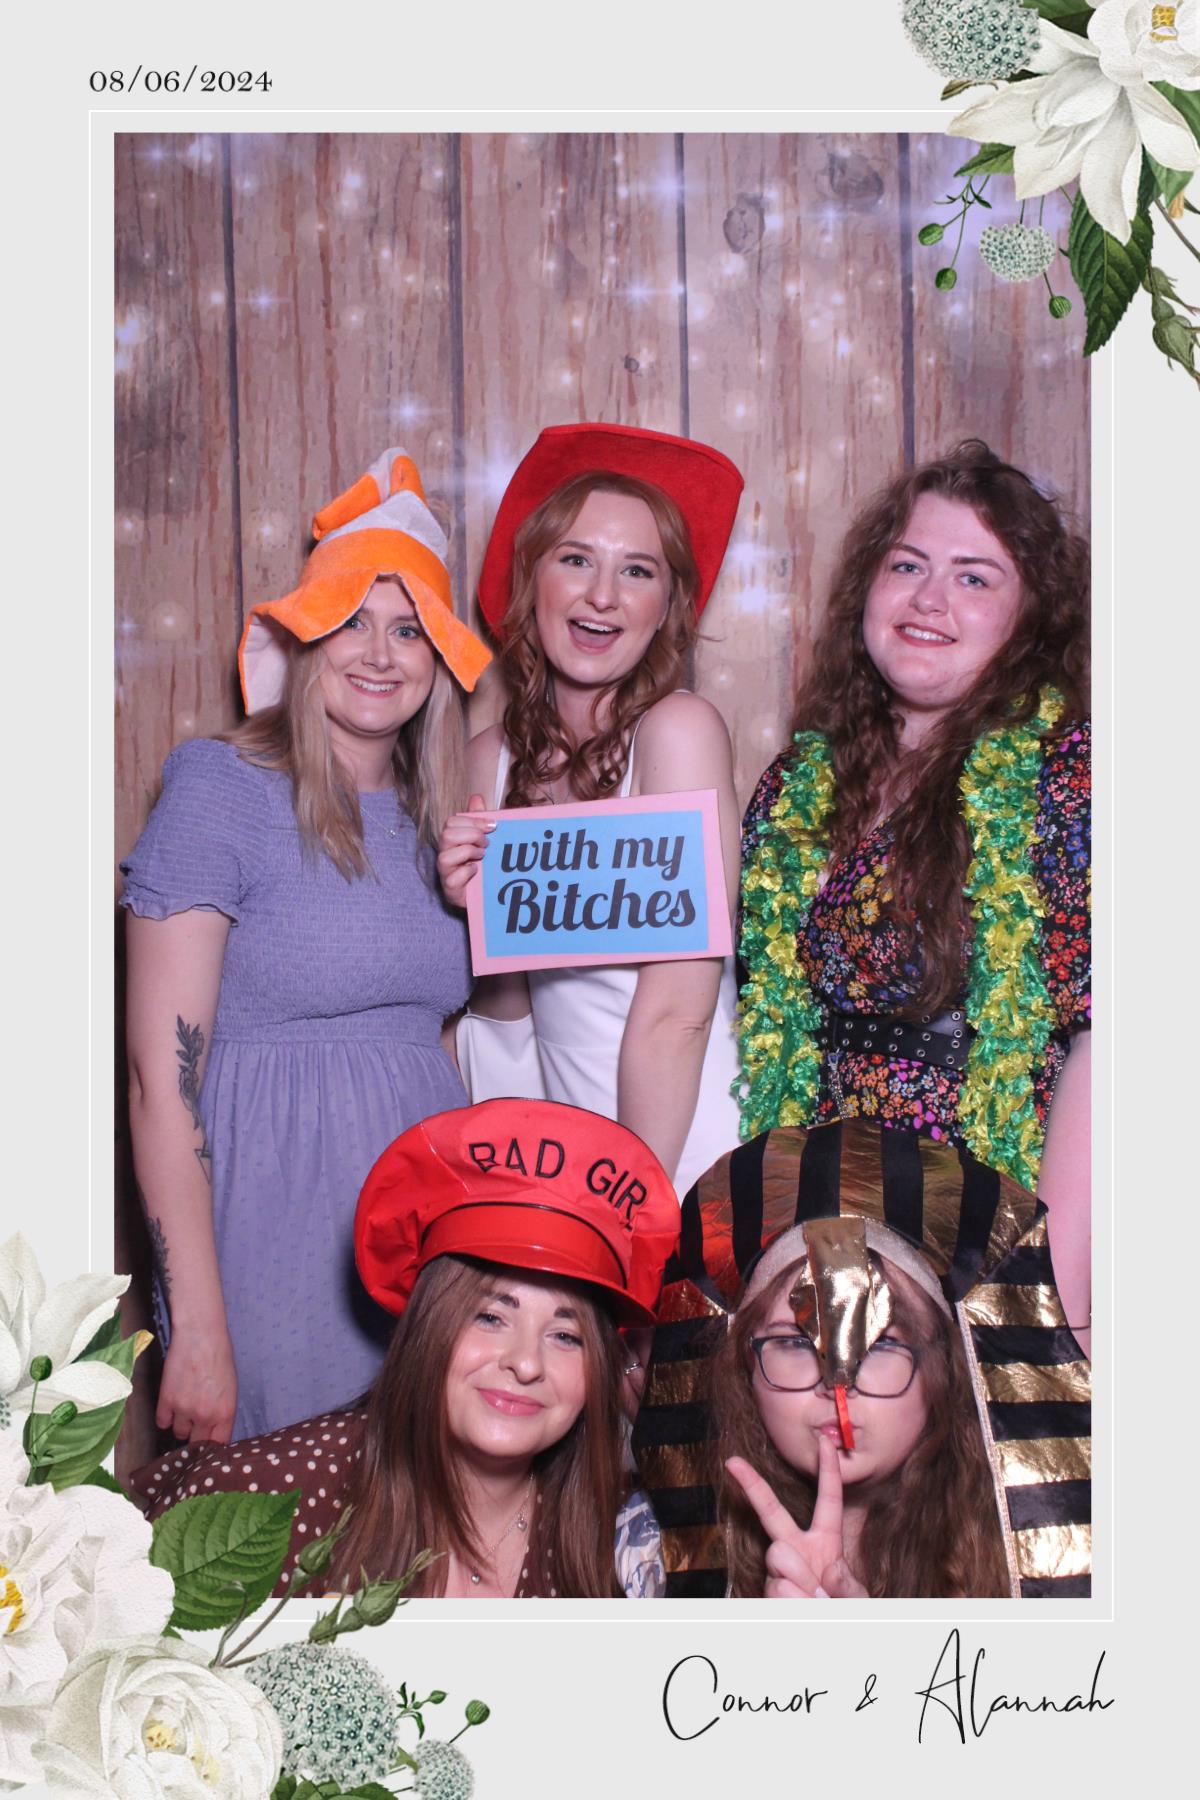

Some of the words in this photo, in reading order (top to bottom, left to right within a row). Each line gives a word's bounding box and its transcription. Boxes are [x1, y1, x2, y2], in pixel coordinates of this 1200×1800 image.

[501, 828, 600, 873] with
[611, 835, 685, 881] my
[497, 878, 696, 934] Bitches
[469, 1138, 566, 1179] BAD
